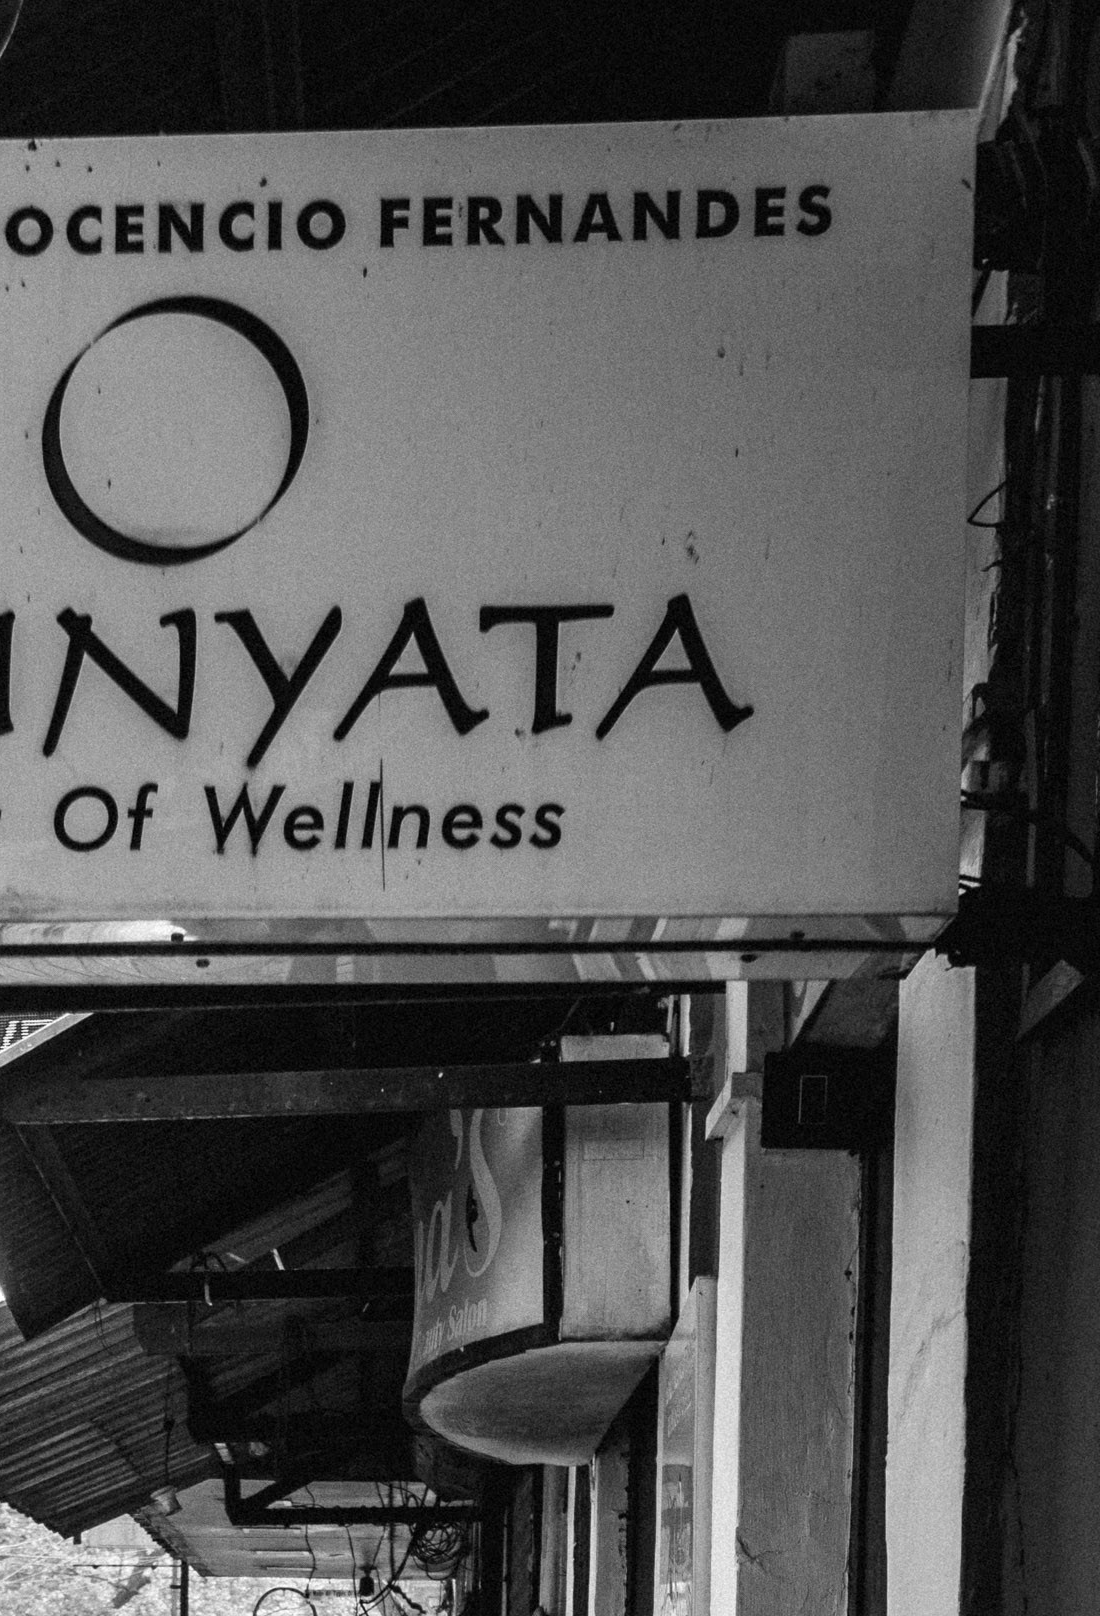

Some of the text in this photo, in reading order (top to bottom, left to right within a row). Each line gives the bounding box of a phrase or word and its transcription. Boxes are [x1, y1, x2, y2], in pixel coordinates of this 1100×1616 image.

[378, 185, 836, 250] FERNANDES
[52, 782, 160, 854] Of
[202, 779, 568, 858] Wellness
